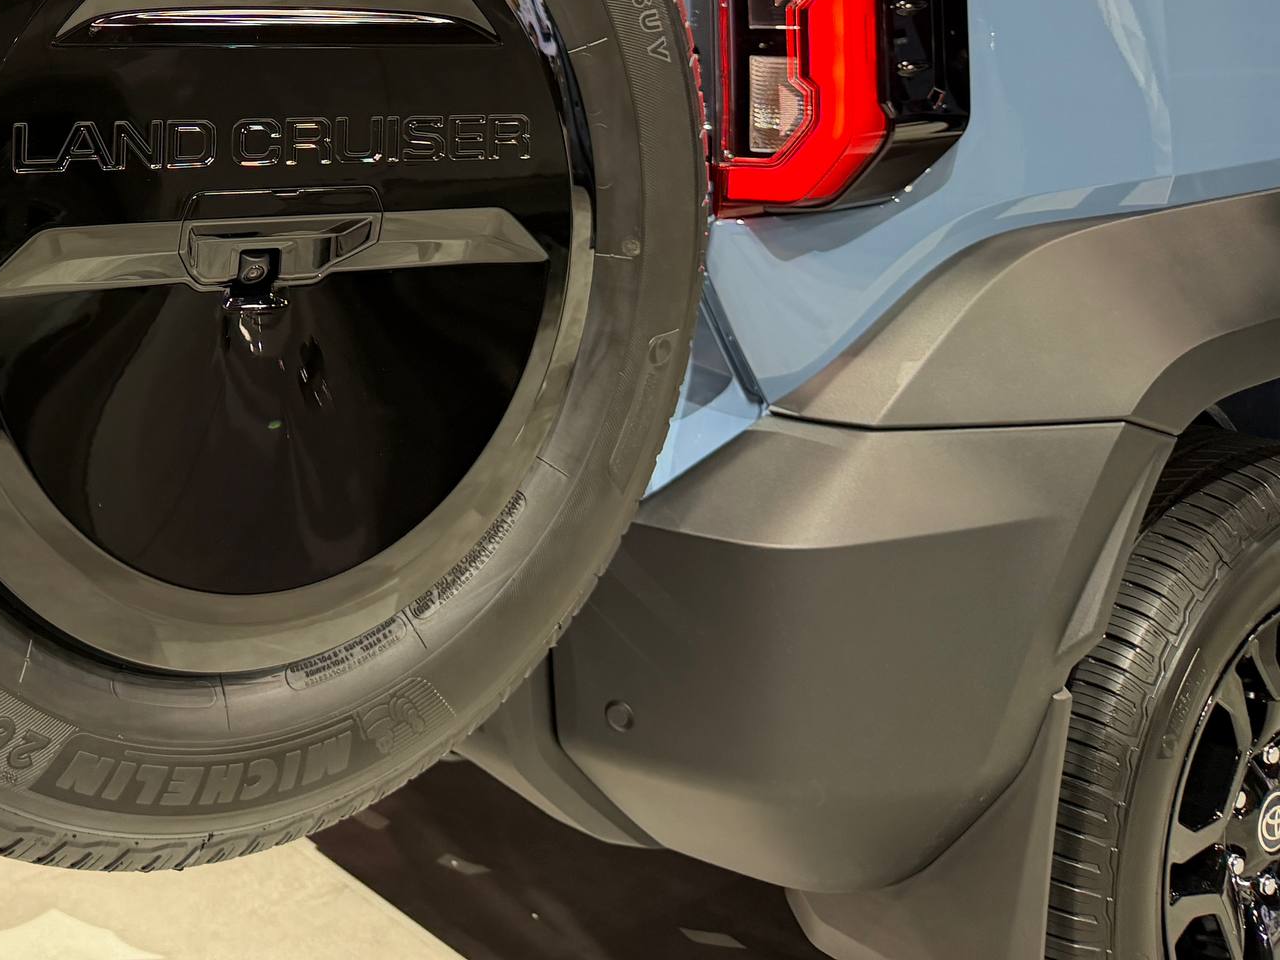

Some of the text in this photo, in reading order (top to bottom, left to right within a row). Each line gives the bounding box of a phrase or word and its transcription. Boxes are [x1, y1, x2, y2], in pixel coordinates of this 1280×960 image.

[12, 113, 532, 176] LAND CRUISER
[57, 739, 350, 805] MICHELIN
